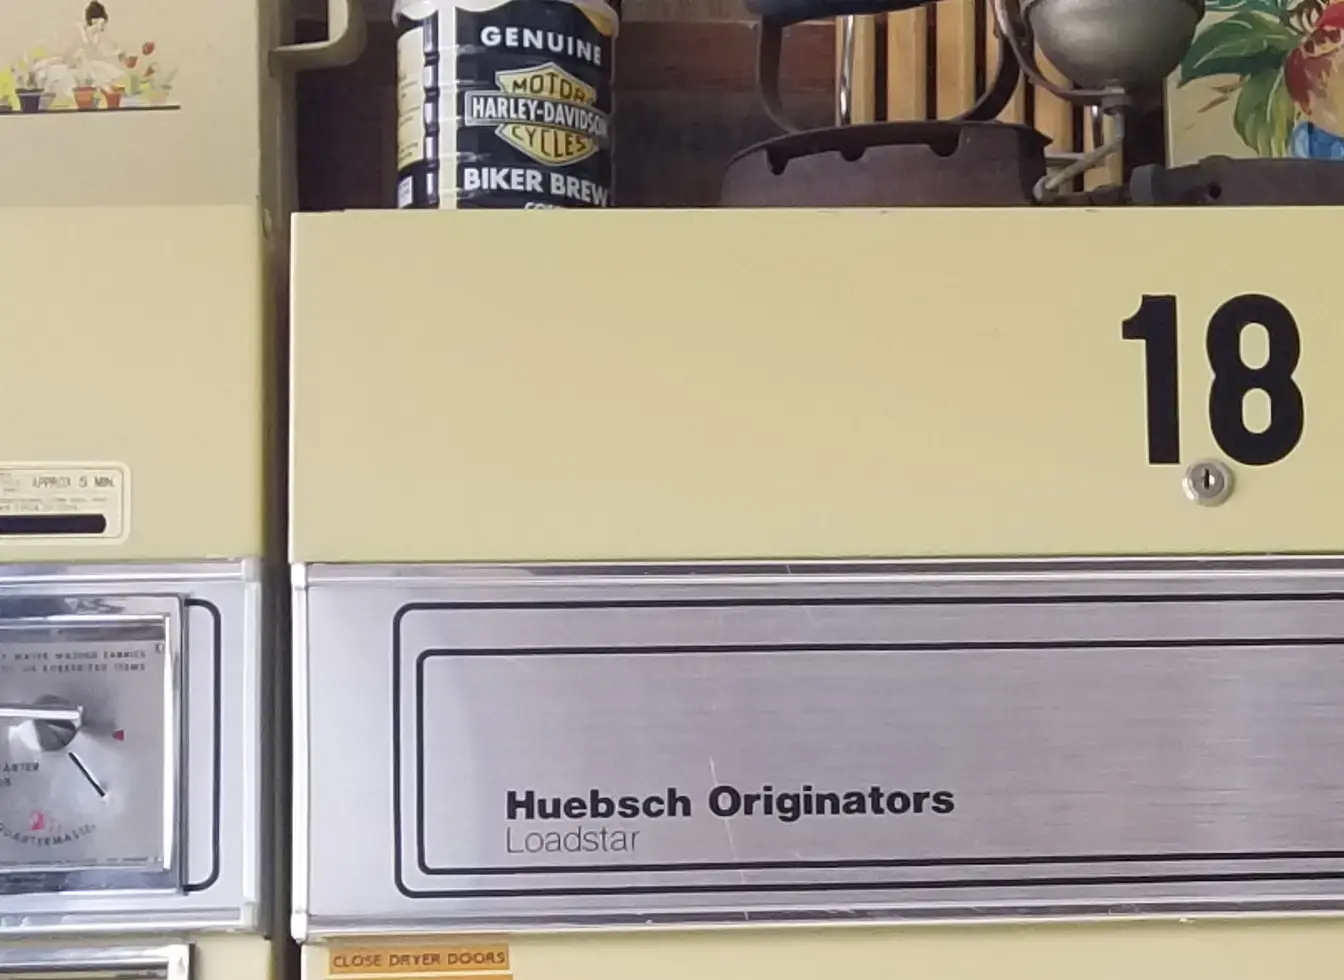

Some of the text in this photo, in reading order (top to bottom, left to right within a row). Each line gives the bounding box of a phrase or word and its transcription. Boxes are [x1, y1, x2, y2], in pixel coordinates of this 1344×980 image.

[481, 26, 602, 66] GENUINE
[512, 73, 587, 103] MOTOR
[472, 97, 609, 138] HARLEY-DAVIDSON
[511, 126, 587, 158] CYCLES
[463, 168, 609, 207] BIKER BREW
[1122, 293, 1305, 466] 18
[506, 785, 956, 823] Huebsch Originators
[506, 826, 641, 853] Loadstar
[333, 951, 505, 967] CLOSE DRYER DOORS
